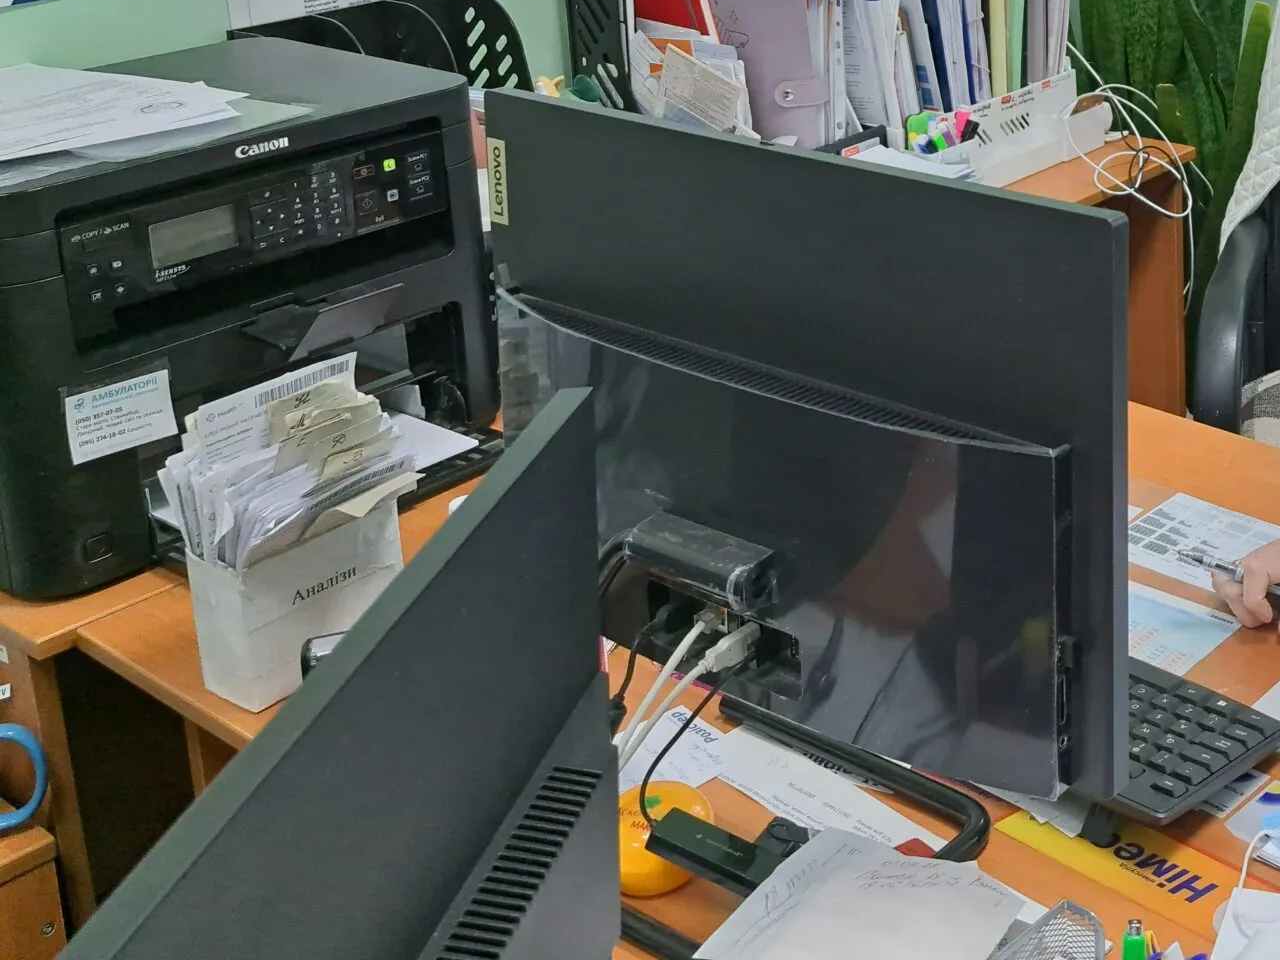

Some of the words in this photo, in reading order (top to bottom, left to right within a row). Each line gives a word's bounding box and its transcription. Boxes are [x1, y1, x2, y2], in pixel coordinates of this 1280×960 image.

[235, 137, 289, 158] Canon
[493, 146, 504, 217] Lenovo
[82, 230, 98, 240] COPY
[112, 222, 129, 232] SCAN
[91, 377, 157, 402] АМБУЛАТОРІЇ
[292, 567, 356, 605] Аналізи
[671, 711, 719, 743] Розісер
